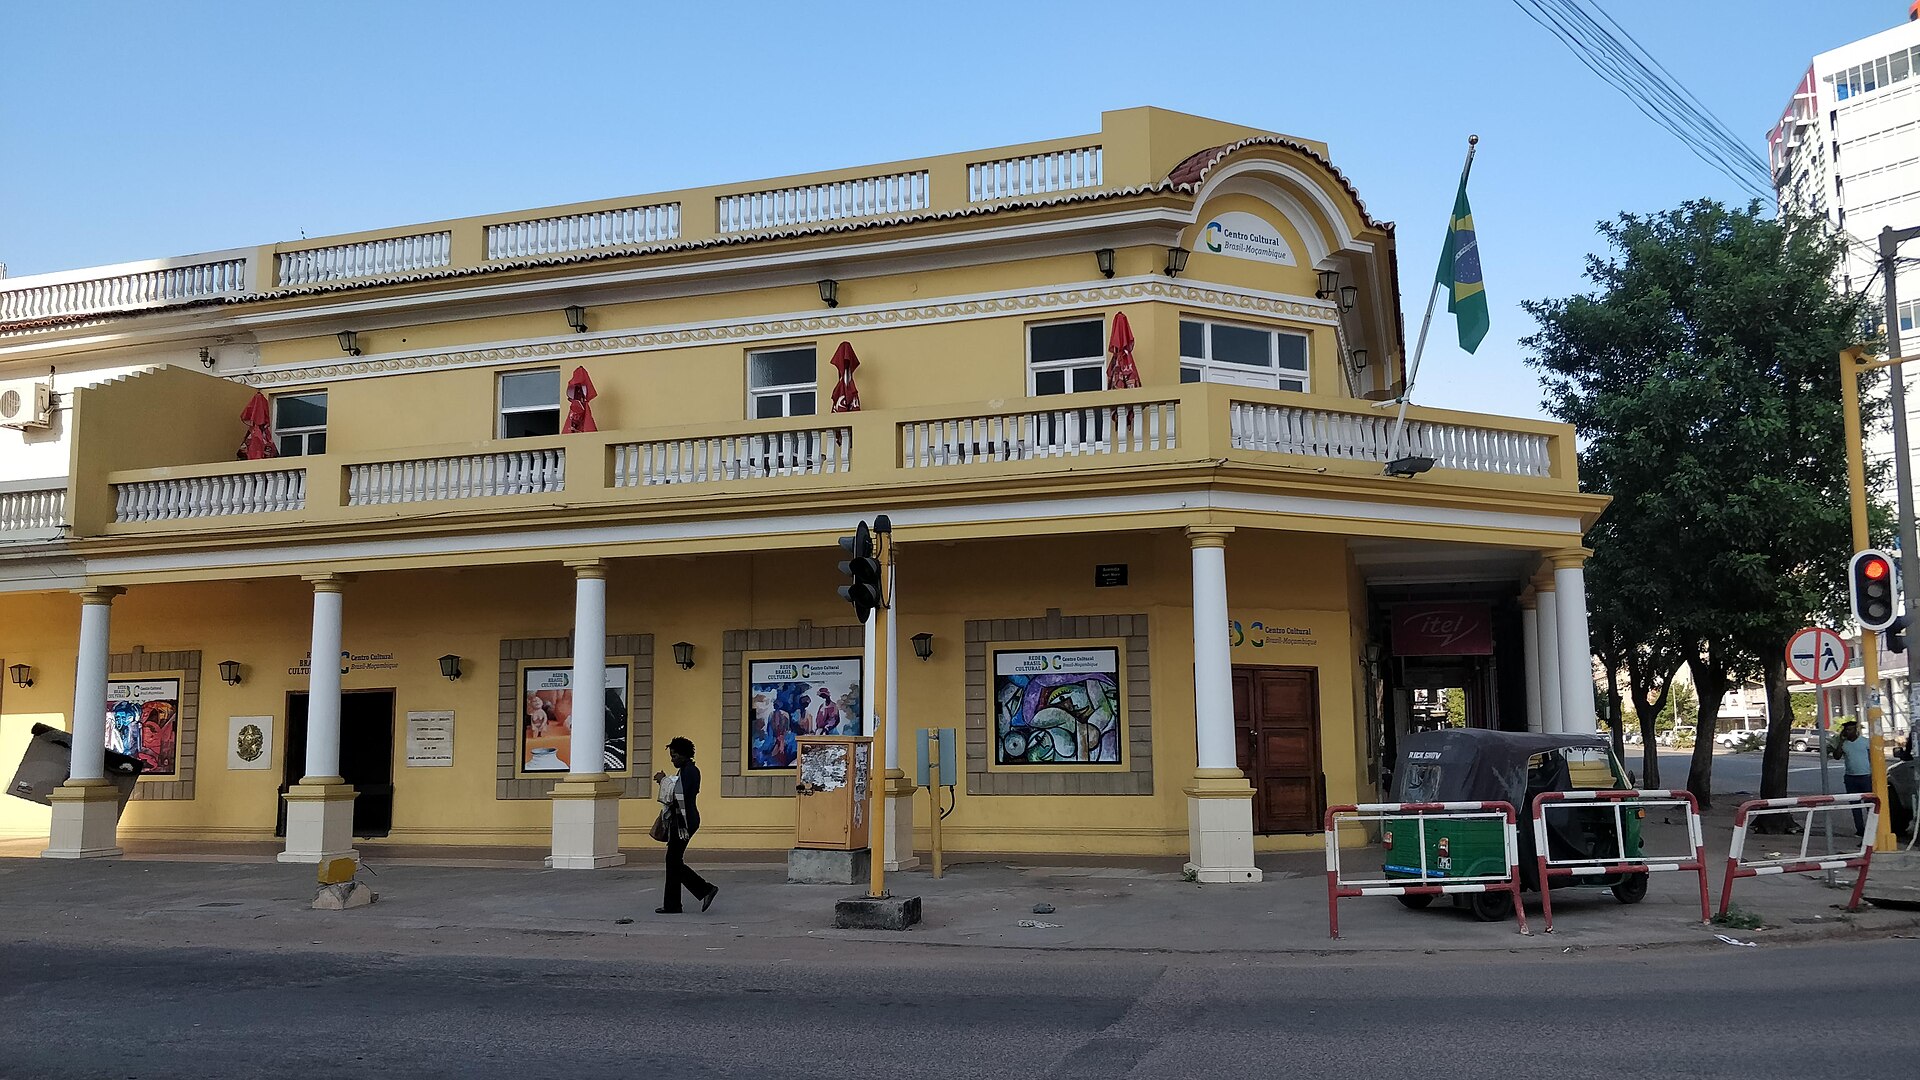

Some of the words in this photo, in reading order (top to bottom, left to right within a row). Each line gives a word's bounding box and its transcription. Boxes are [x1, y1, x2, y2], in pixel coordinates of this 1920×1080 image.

[1224, 229, 1249, 241] Centro
[1250, 233, 1280, 246] Cultural
[1224, 241, 1287, 259] Brasil-Moçambique
[1265, 626, 1285, 634] Centro
[1286, 627, 1311, 636] Cultural
[1421, 616, 1464, 633] itel
[370, 652, 394, 660] Cultural
